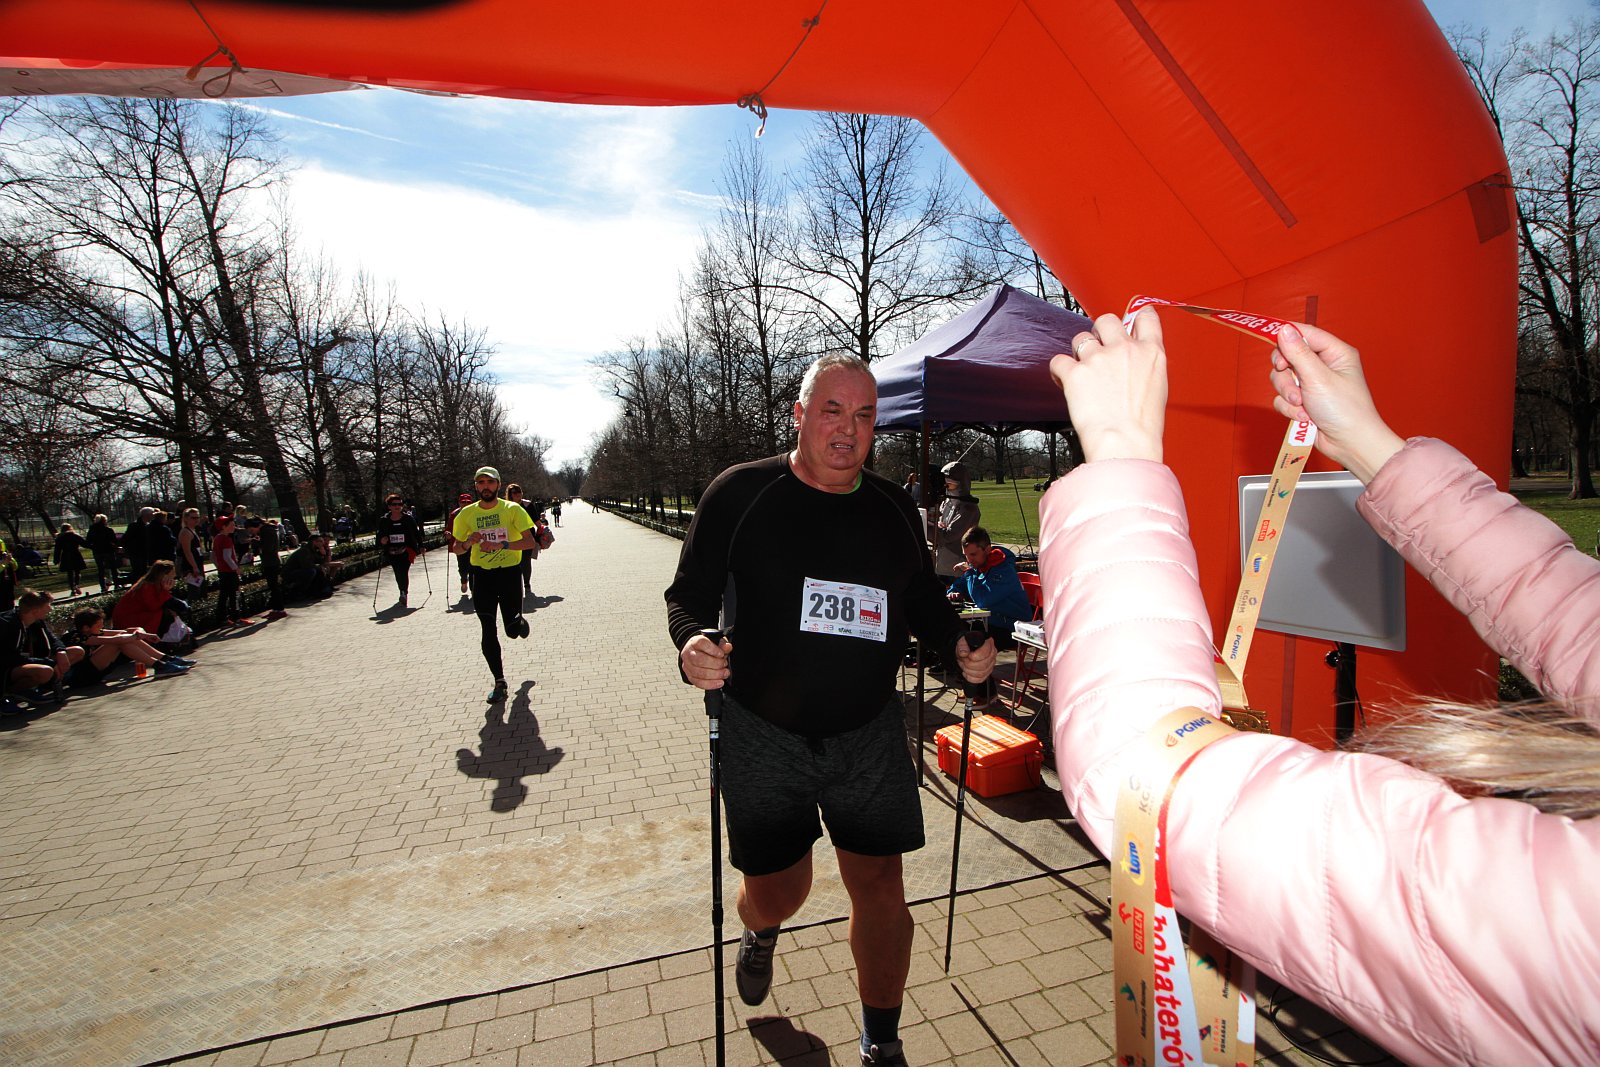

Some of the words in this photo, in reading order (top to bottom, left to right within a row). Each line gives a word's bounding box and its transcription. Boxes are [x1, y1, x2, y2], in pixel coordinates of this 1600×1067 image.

[1217, 312, 1268, 329] BIEG
[808, 592, 855, 622] 238
[1174, 716, 1212, 738] PGNiG
[1128, 841, 1141, 875] LOTTO
[1134, 909, 1144, 952] ORLEN
[1154, 915, 1195, 1067] bohateró
